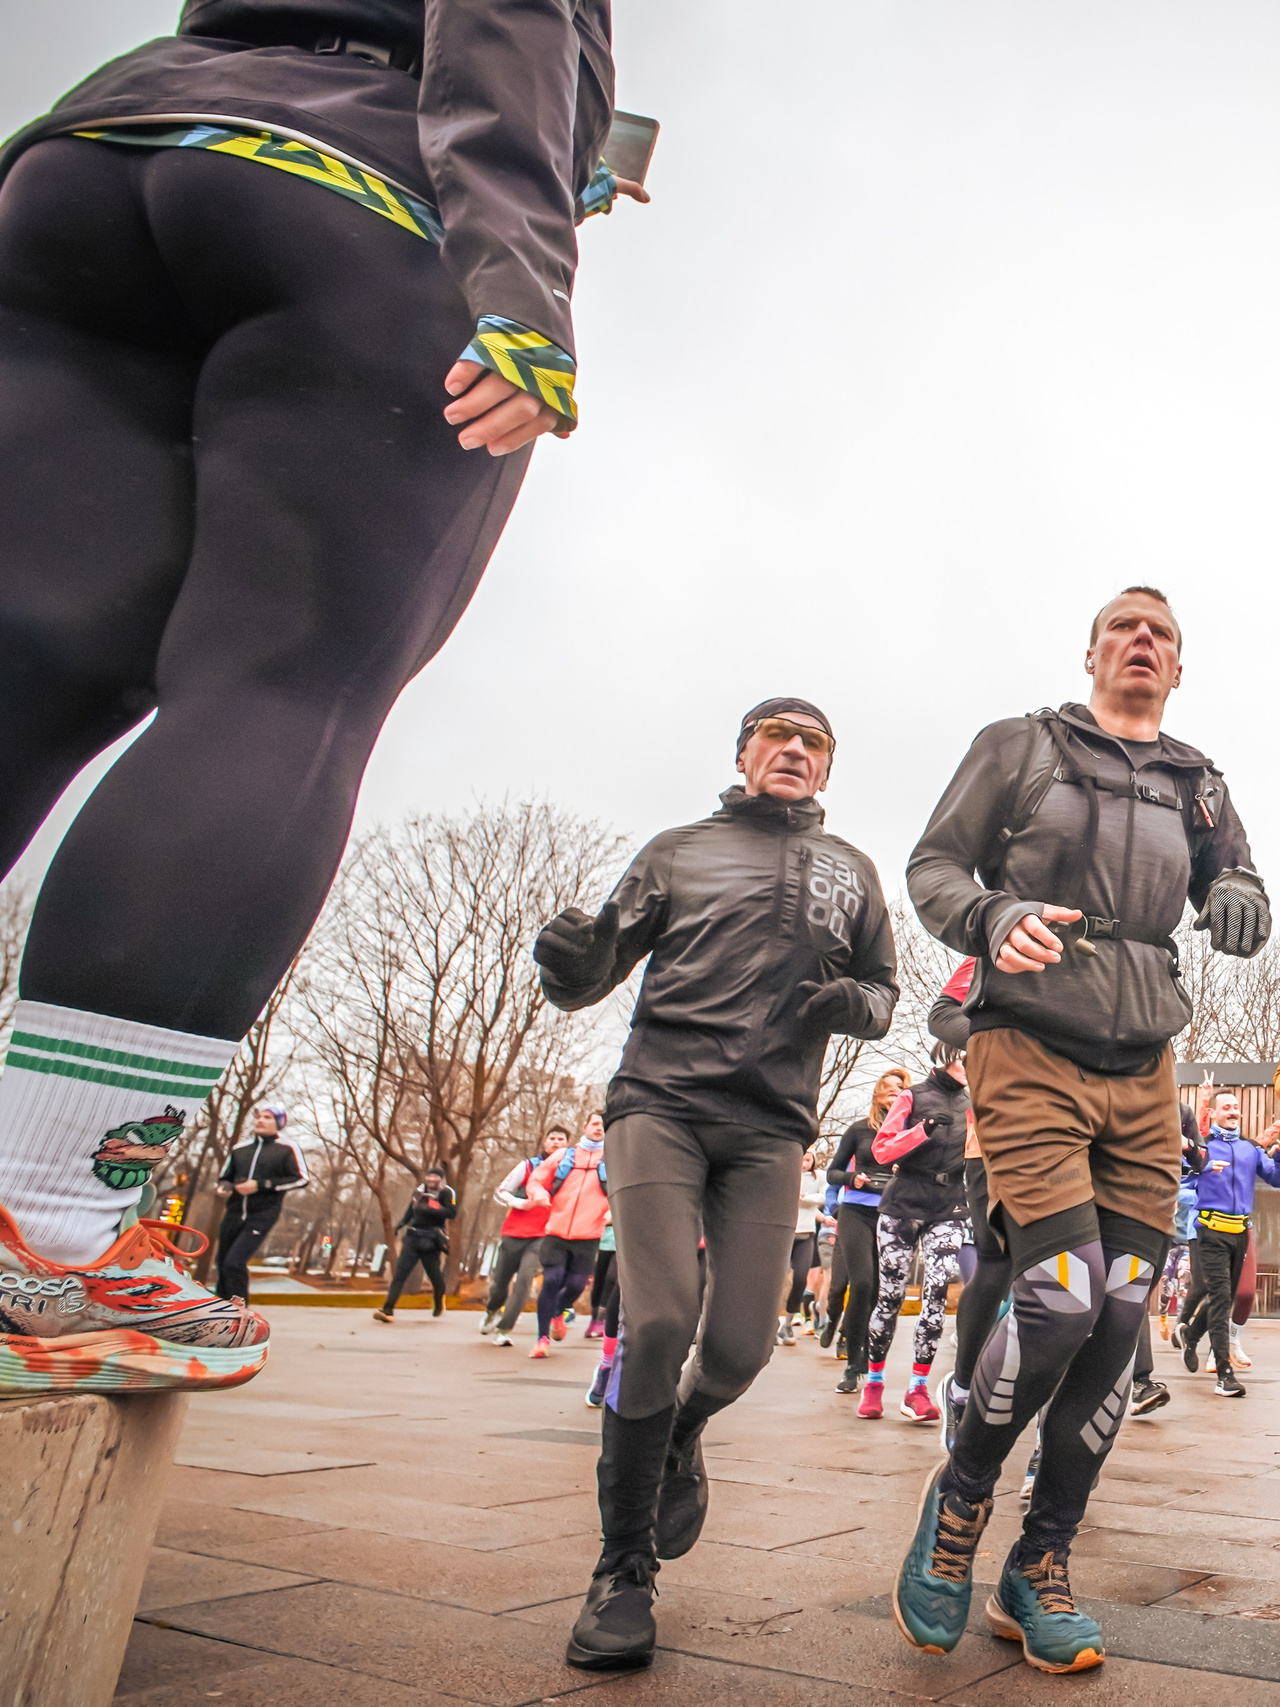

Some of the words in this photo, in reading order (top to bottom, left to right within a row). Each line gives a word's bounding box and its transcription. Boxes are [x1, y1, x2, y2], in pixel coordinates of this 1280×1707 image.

[812, 853, 864, 896] sal
[810, 876, 859, 919] om
[0, 1272, 83, 1296] OOSA
